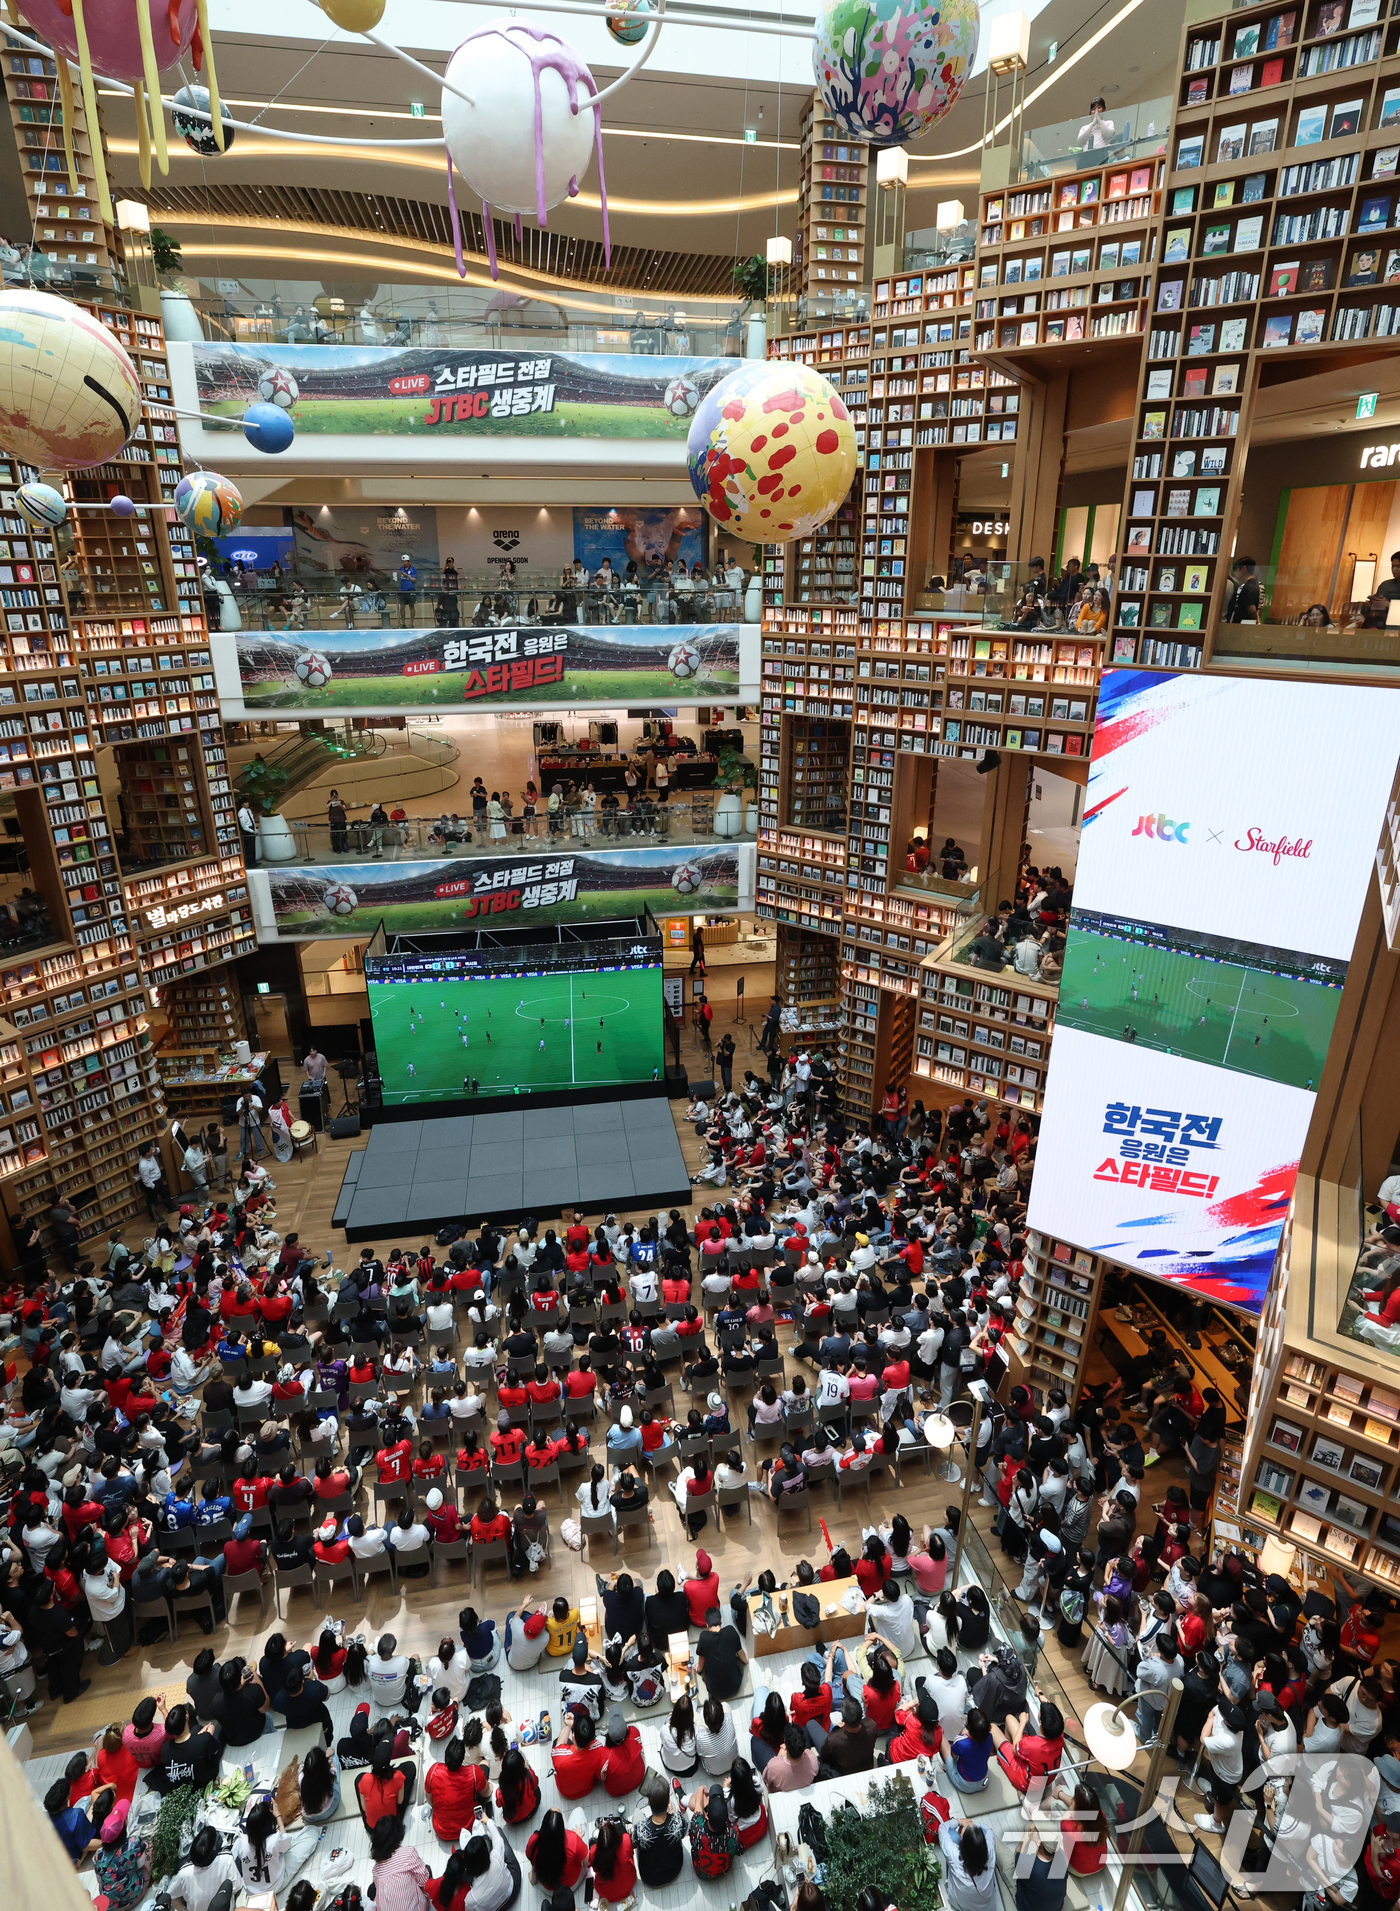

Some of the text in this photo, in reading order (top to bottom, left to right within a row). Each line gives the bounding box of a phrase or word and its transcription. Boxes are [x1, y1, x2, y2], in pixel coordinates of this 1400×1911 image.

[401, 377, 425, 390] LIVE
[434, 358, 553, 392] 스타필드 전점
[424, 383, 557, 425] JTBC 생중계
[1360, 443, 1400, 469] rar
[492, 530, 520, 539] arena
[443, 631, 568, 671] 한국전 응원은
[413, 661, 436, 673] LIVE
[463, 655, 563, 699] 스타필드!
[1131, 813, 1191, 845] jtbc
[1234, 827, 1313, 866] Starfield
[473, 859, 575, 893] 스타필드 전점
[445, 882, 466, 894] LIVE
[464, 878, 579, 918] JTBC 생중계
[145, 894, 224, 929] 별마당도서관
[1102, 1101, 1225, 1151] 한국전
[1119, 1138, 1190, 1167] 응원은
[1092, 1157, 1220, 1199] 스타필드!
[638, 1250, 654, 1262] 24
[366, 1268, 374, 1282] 7
[642, 1285, 651, 1300] 7
[628, 1338, 644, 1352] 10
[826, 1382, 839, 1398] 19
[497, 1442, 516, 1456] 11
[391, 1458, 400, 1476] 7
[202, 1505, 223, 1513] CAICEDO
[244, 1493, 254, 1510] 4
[166, 1514, 180, 1530] 8
[200, 1511, 226, 1526] 25
[558, 1630, 572, 1647] 11
[701, 1855, 728, 1874] 23
[248, 1865, 271, 1884] 31
